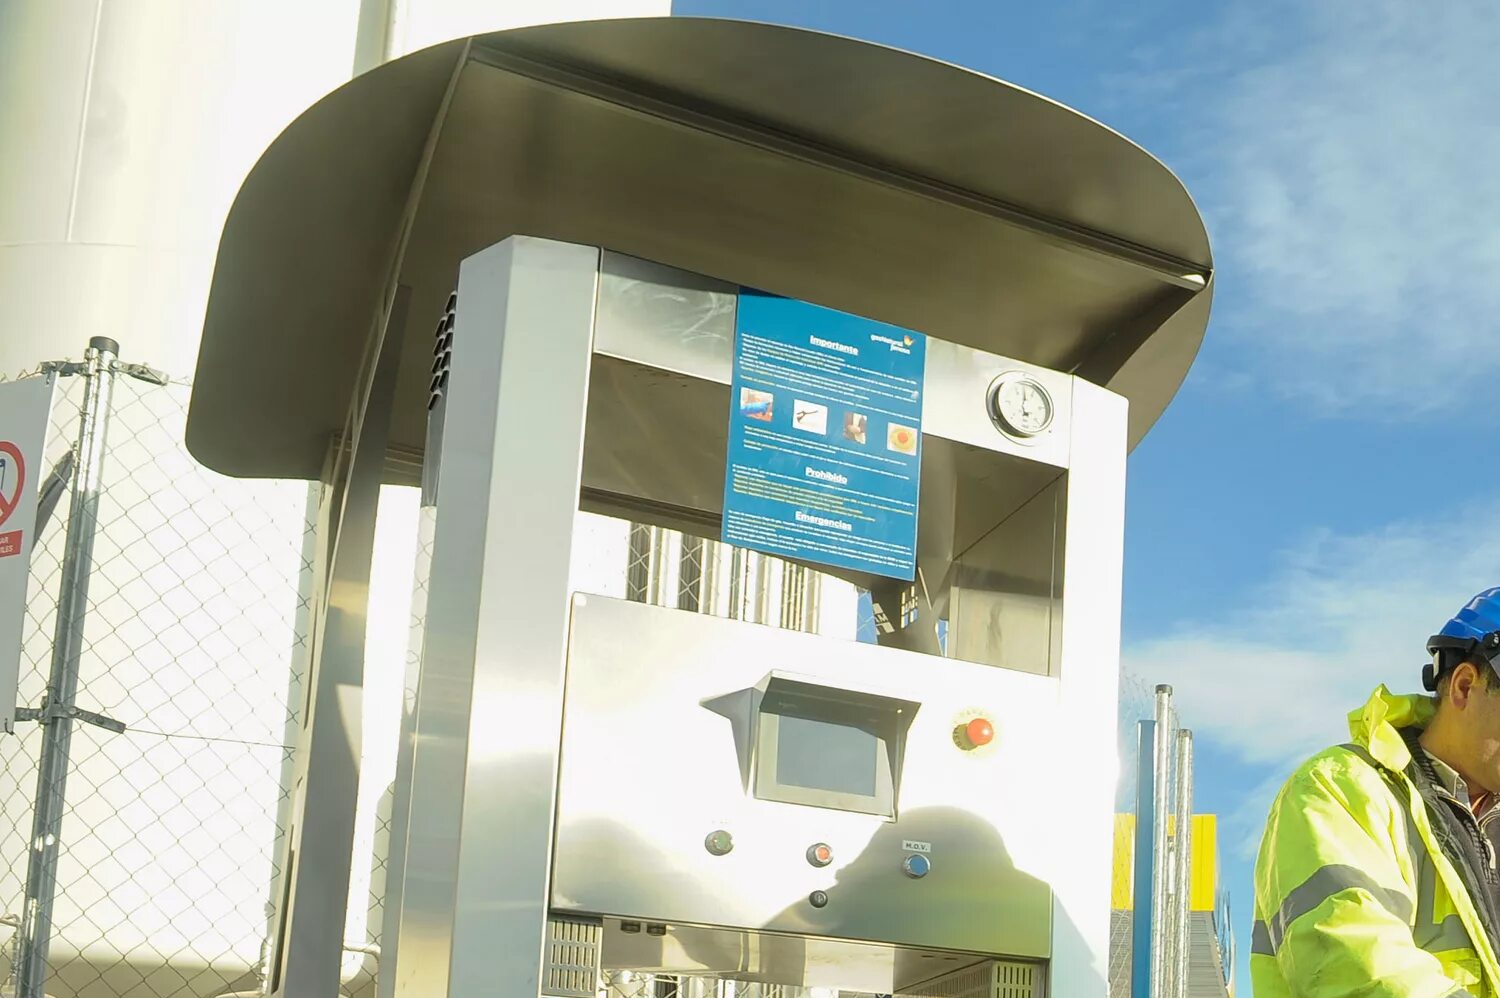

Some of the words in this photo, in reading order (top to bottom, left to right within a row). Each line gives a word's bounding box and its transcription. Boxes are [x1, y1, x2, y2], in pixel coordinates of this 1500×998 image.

[809, 336, 858, 355] Importante
[805, 467, 847, 485] Prohibido
[795, 511, 852, 531] Emergencias
